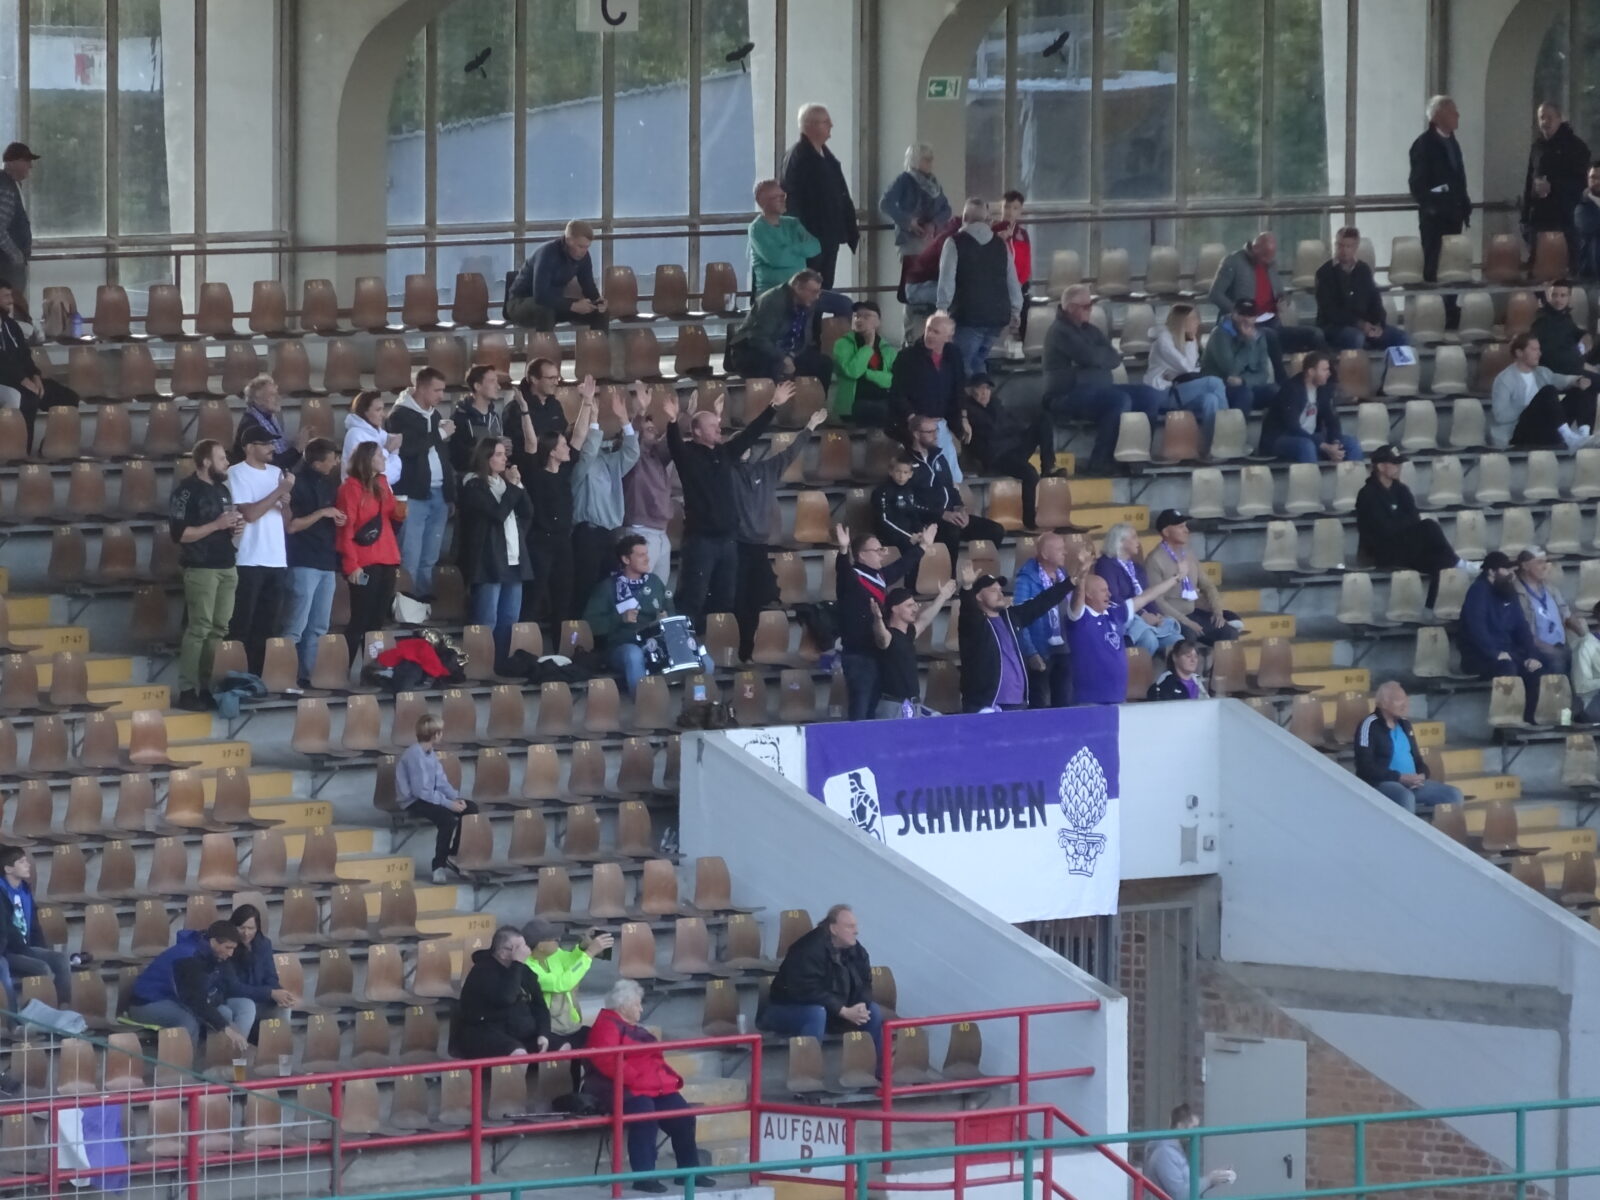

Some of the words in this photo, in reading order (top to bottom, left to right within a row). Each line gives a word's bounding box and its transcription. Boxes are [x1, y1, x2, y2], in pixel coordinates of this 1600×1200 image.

[471, 625, 480, 634] 42
[222, 641, 232, 650] 37
[451, 689, 461, 698] 40
[895, 780, 1047, 836] SCHWABEN
[329, 950, 339, 959] 33
[364, 1011, 374, 1020] 32
[959, 1023, 970, 1032] 40
[851, 1032, 862, 1040] 38
[905, 1028, 916, 1037] 39
